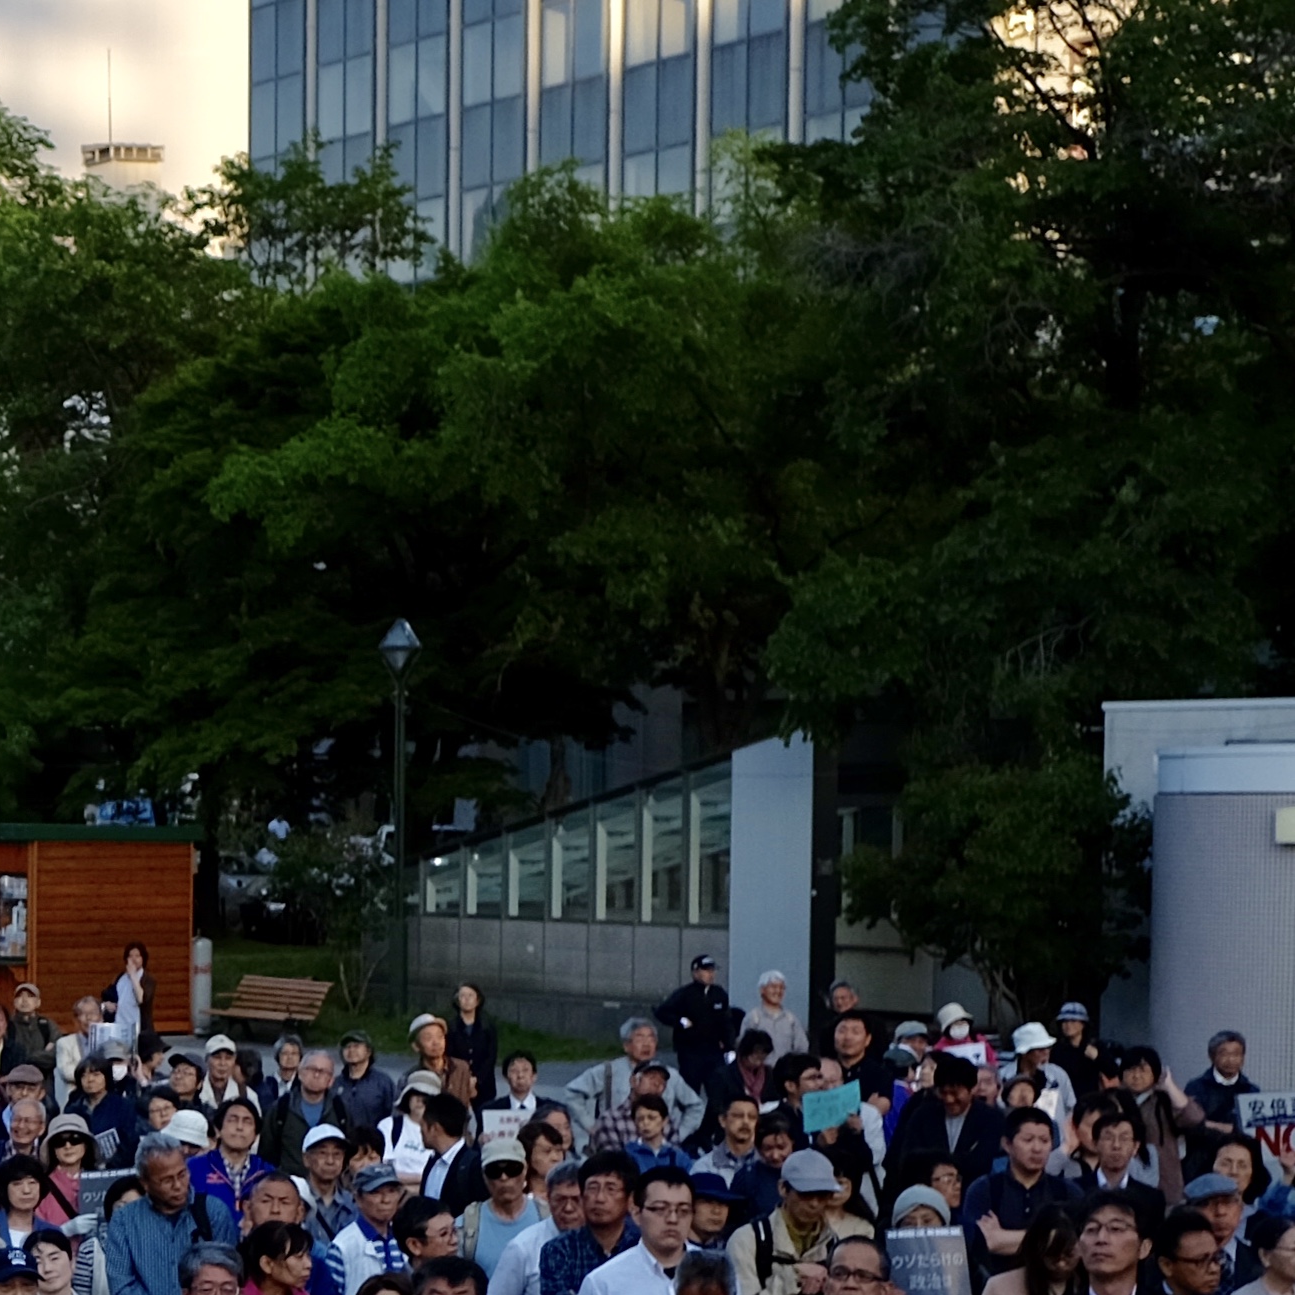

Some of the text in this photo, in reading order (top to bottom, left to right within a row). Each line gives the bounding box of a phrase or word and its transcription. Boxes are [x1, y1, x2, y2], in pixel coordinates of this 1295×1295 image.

[891, 1252, 963, 1269] ウソだらけの
